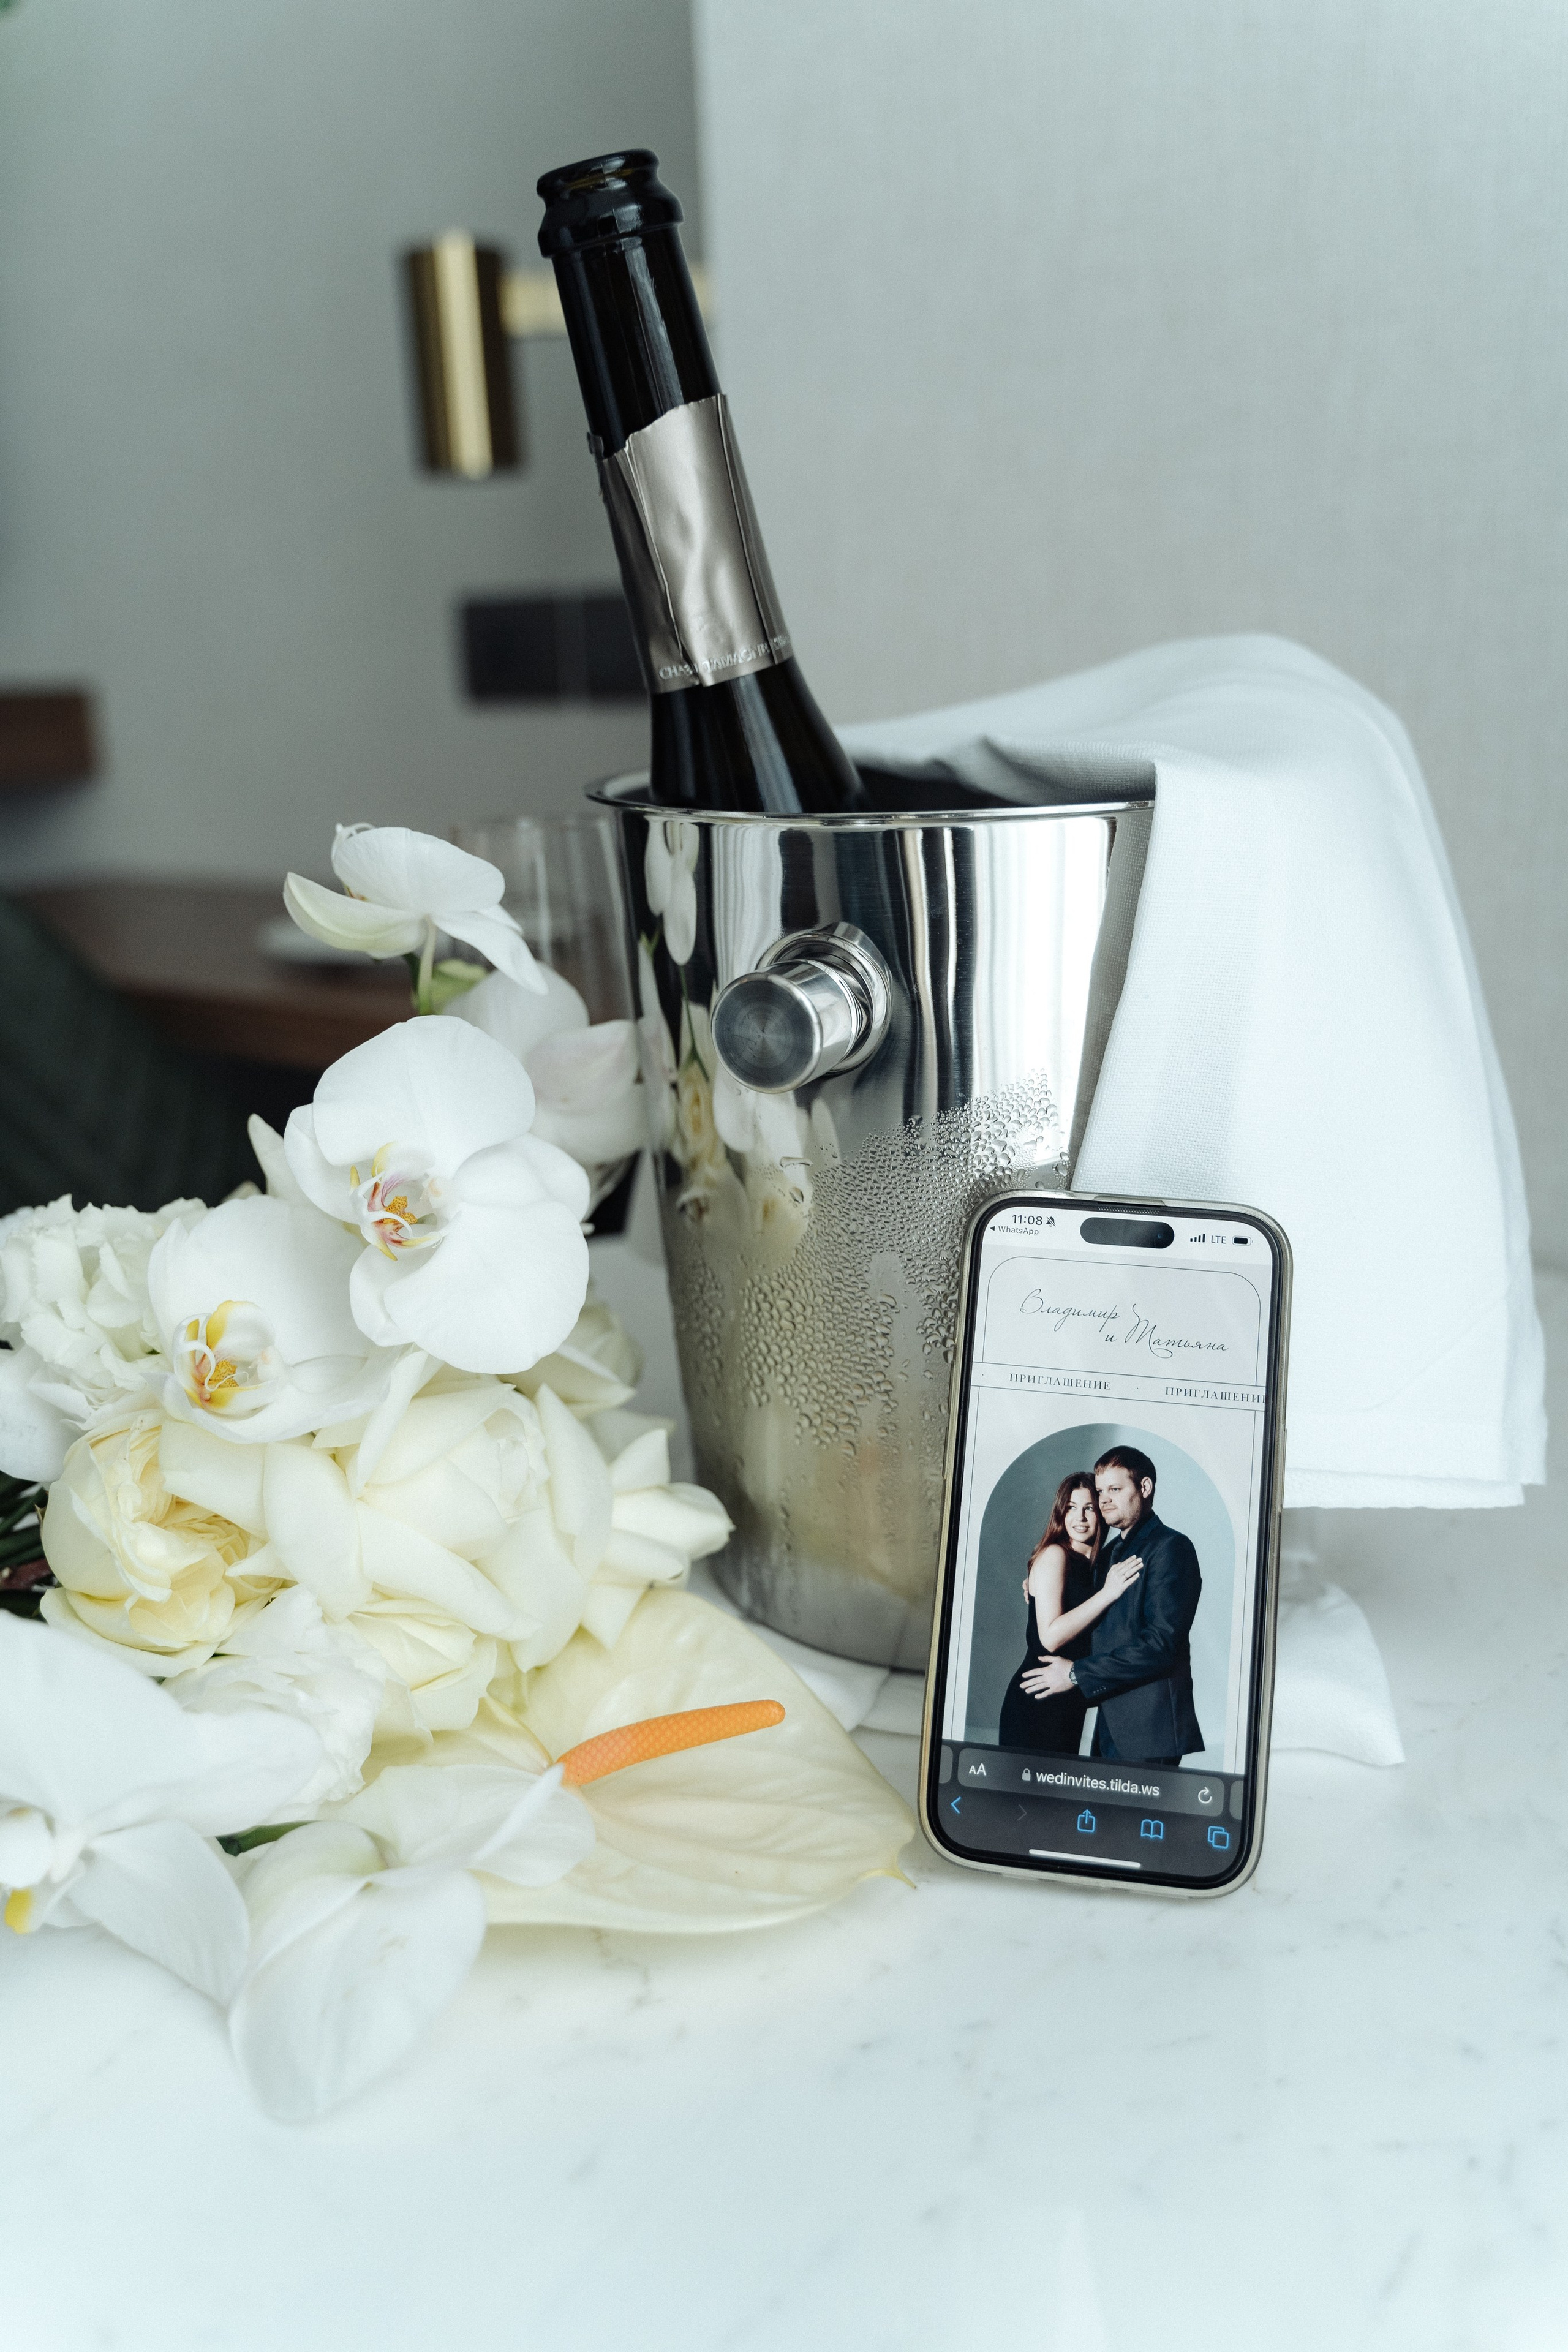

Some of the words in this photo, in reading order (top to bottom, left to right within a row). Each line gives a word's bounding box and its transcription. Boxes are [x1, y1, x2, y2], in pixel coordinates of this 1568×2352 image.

[1012, 1214, 1043, 1226] 11:08
[998, 1225, 1039, 1236] WhatsApp
[1210, 1235, 1227, 1244] LTE
[1019, 1288, 1121, 1333] Владимир
[1104, 1333, 1118, 1343] и
[1124, 1303, 1229, 1359] Татьяна
[1009, 1373, 1111, 1390] ПРИГЛАШЕНИЕ
[1036, 1771, 1160, 1796] wedinvites.tilda.ws
